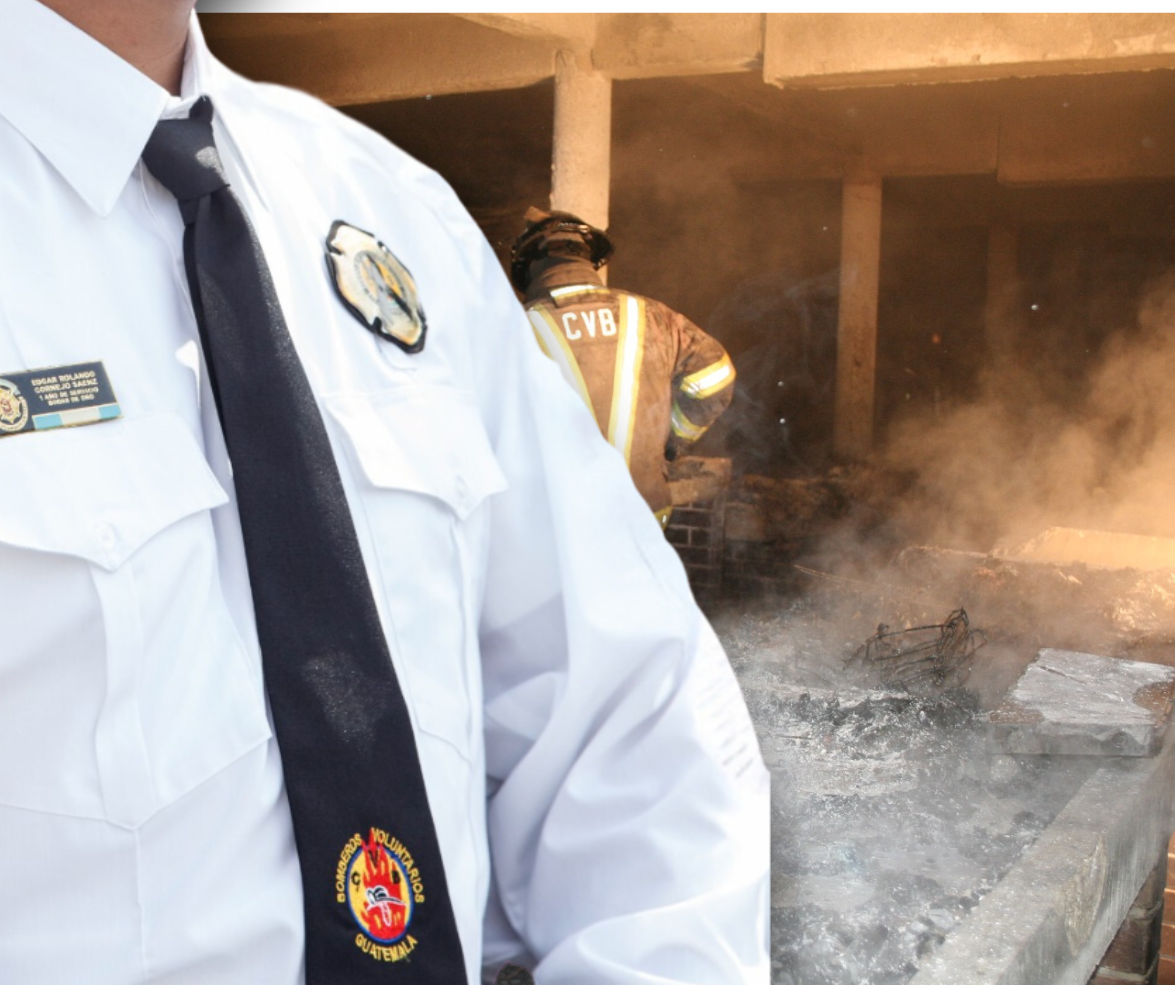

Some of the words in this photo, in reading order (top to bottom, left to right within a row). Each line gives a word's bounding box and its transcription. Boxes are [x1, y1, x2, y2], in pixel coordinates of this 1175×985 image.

[561, 308, 617, 341] CVB
[31, 377, 57, 386] EDGAR
[58, 371, 95, 381] ROLANDO
[34, 383, 71, 393] CORNEJO
[335, 832, 362, 903] BOMBEROS
[371, 826, 425, 903] VOLUNTARIOS
[355, 933, 418, 962] GUATEMALA
